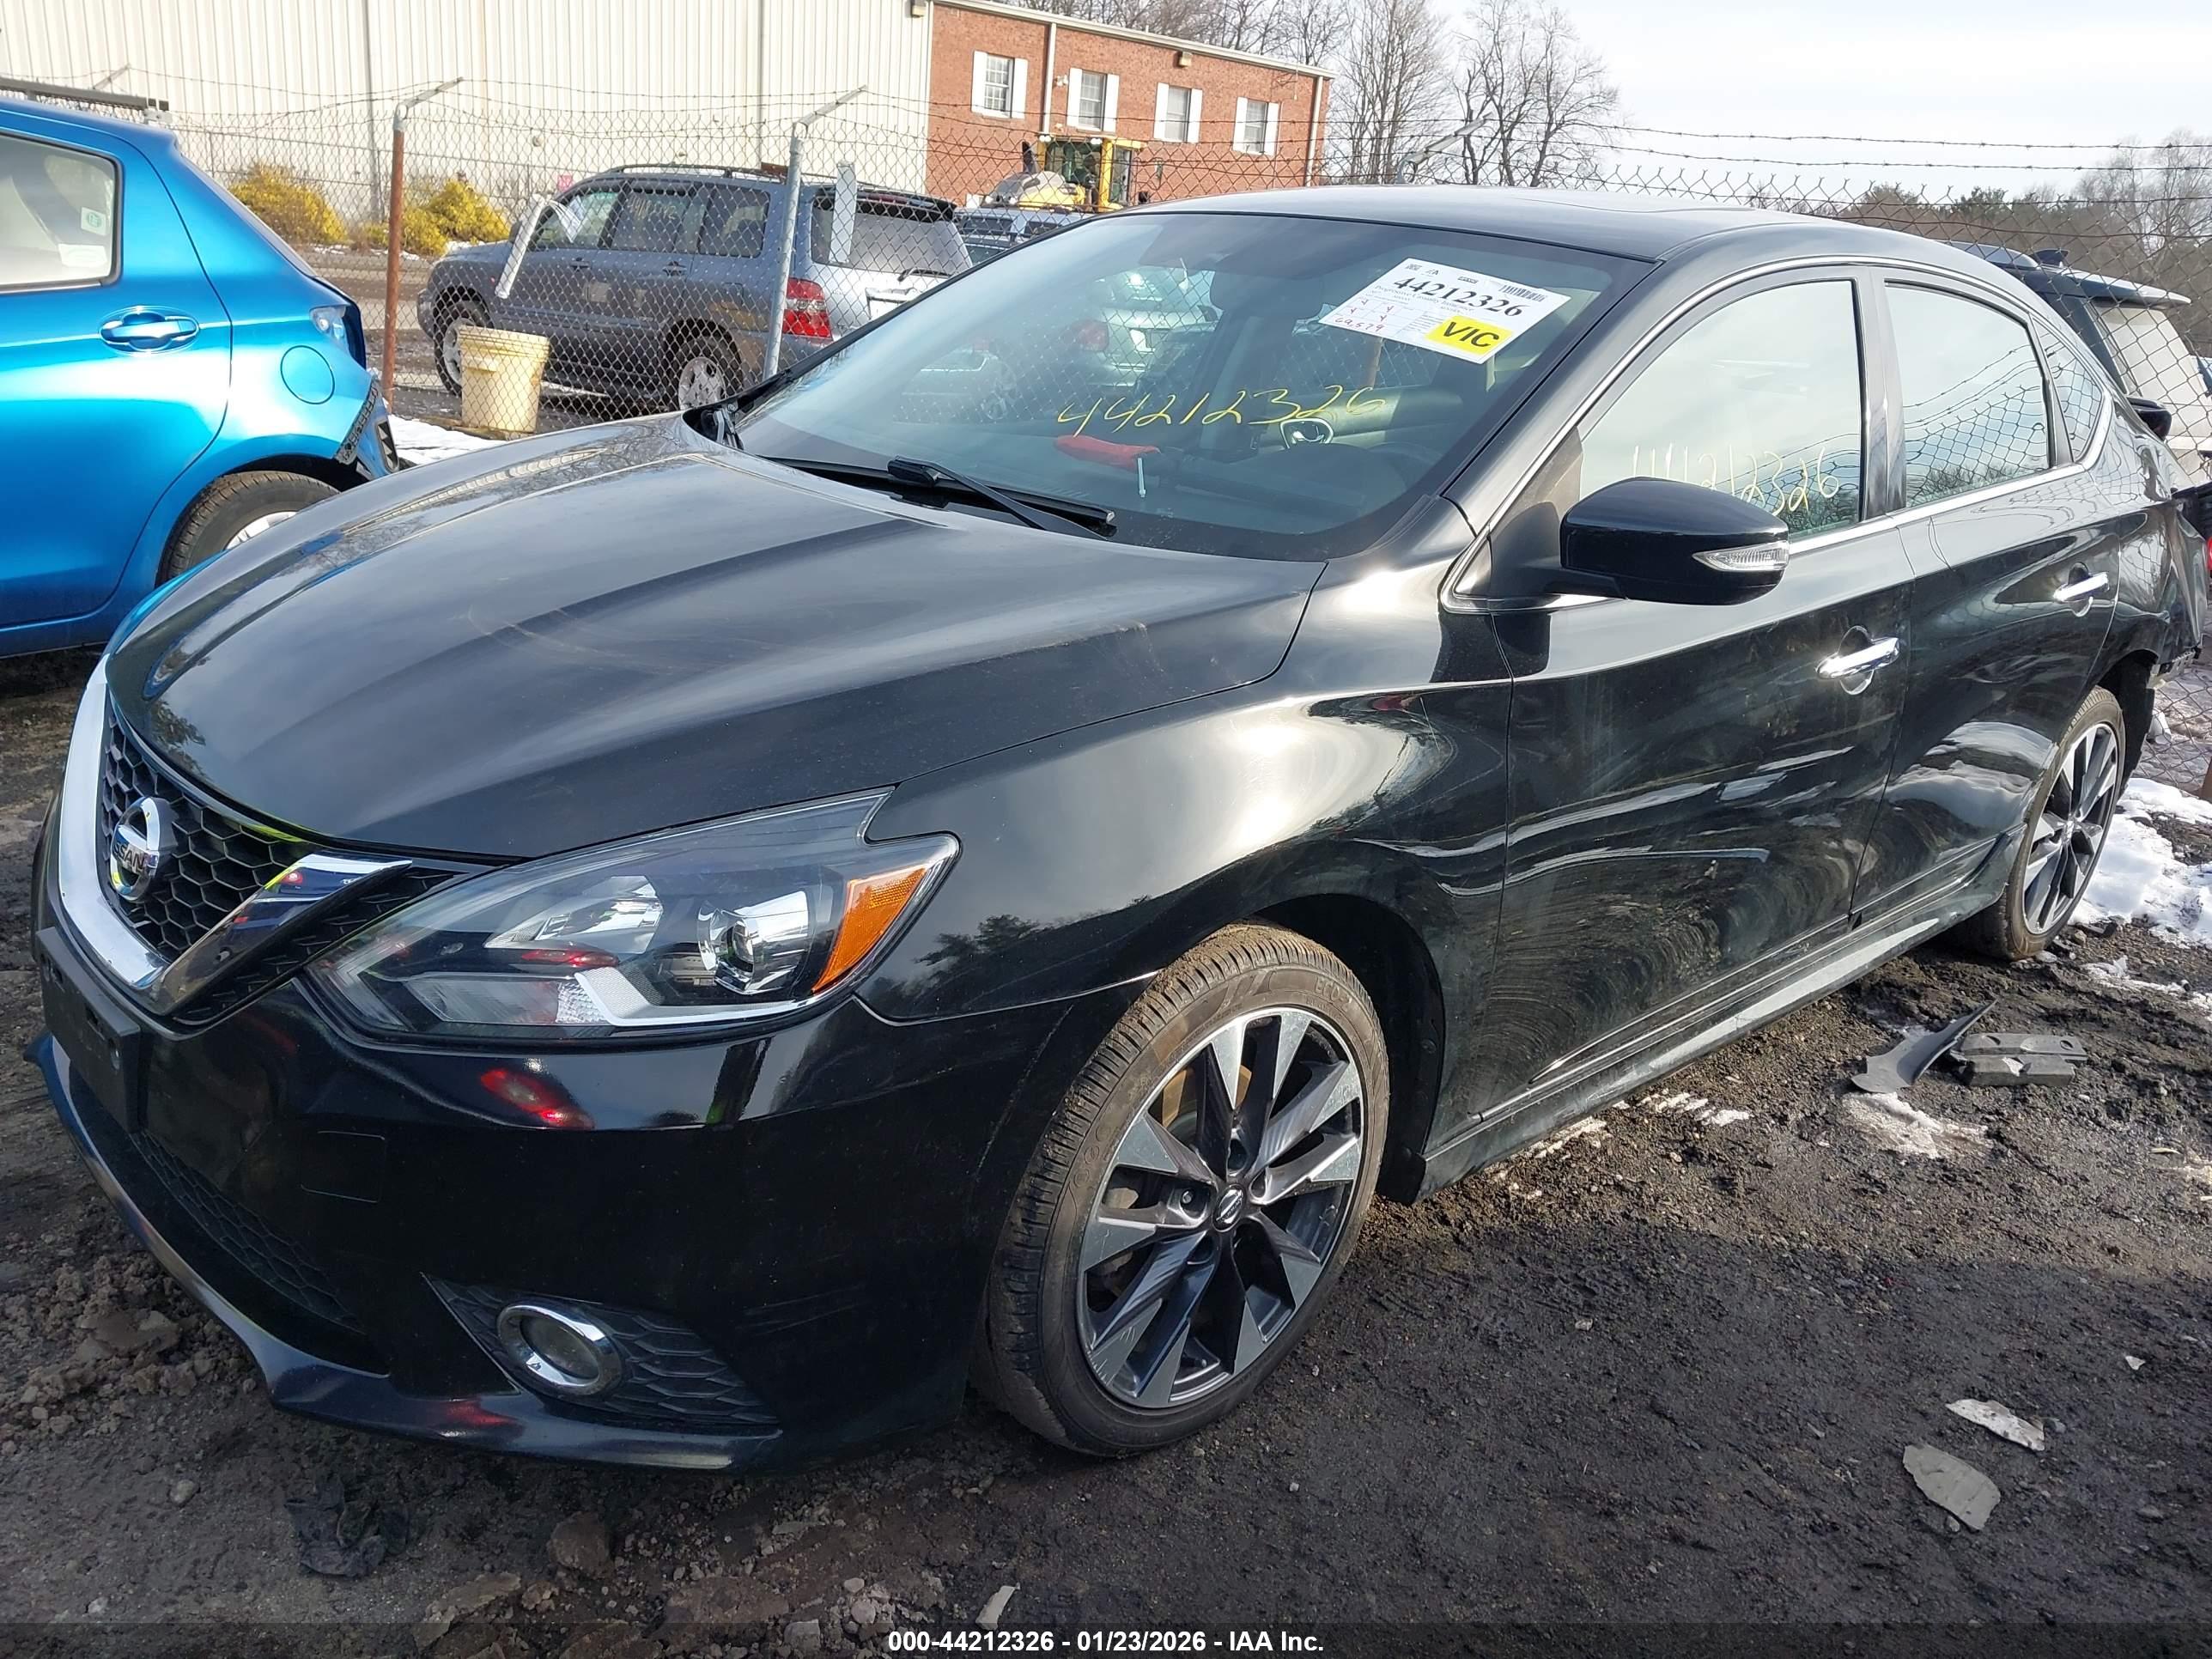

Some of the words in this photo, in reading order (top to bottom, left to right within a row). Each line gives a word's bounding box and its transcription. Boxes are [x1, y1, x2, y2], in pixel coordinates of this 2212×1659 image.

[1393, 276, 1528, 317] 44212326
[1443, 321, 1500, 348] VIC
[1057, 385, 1387, 438] 44212326
